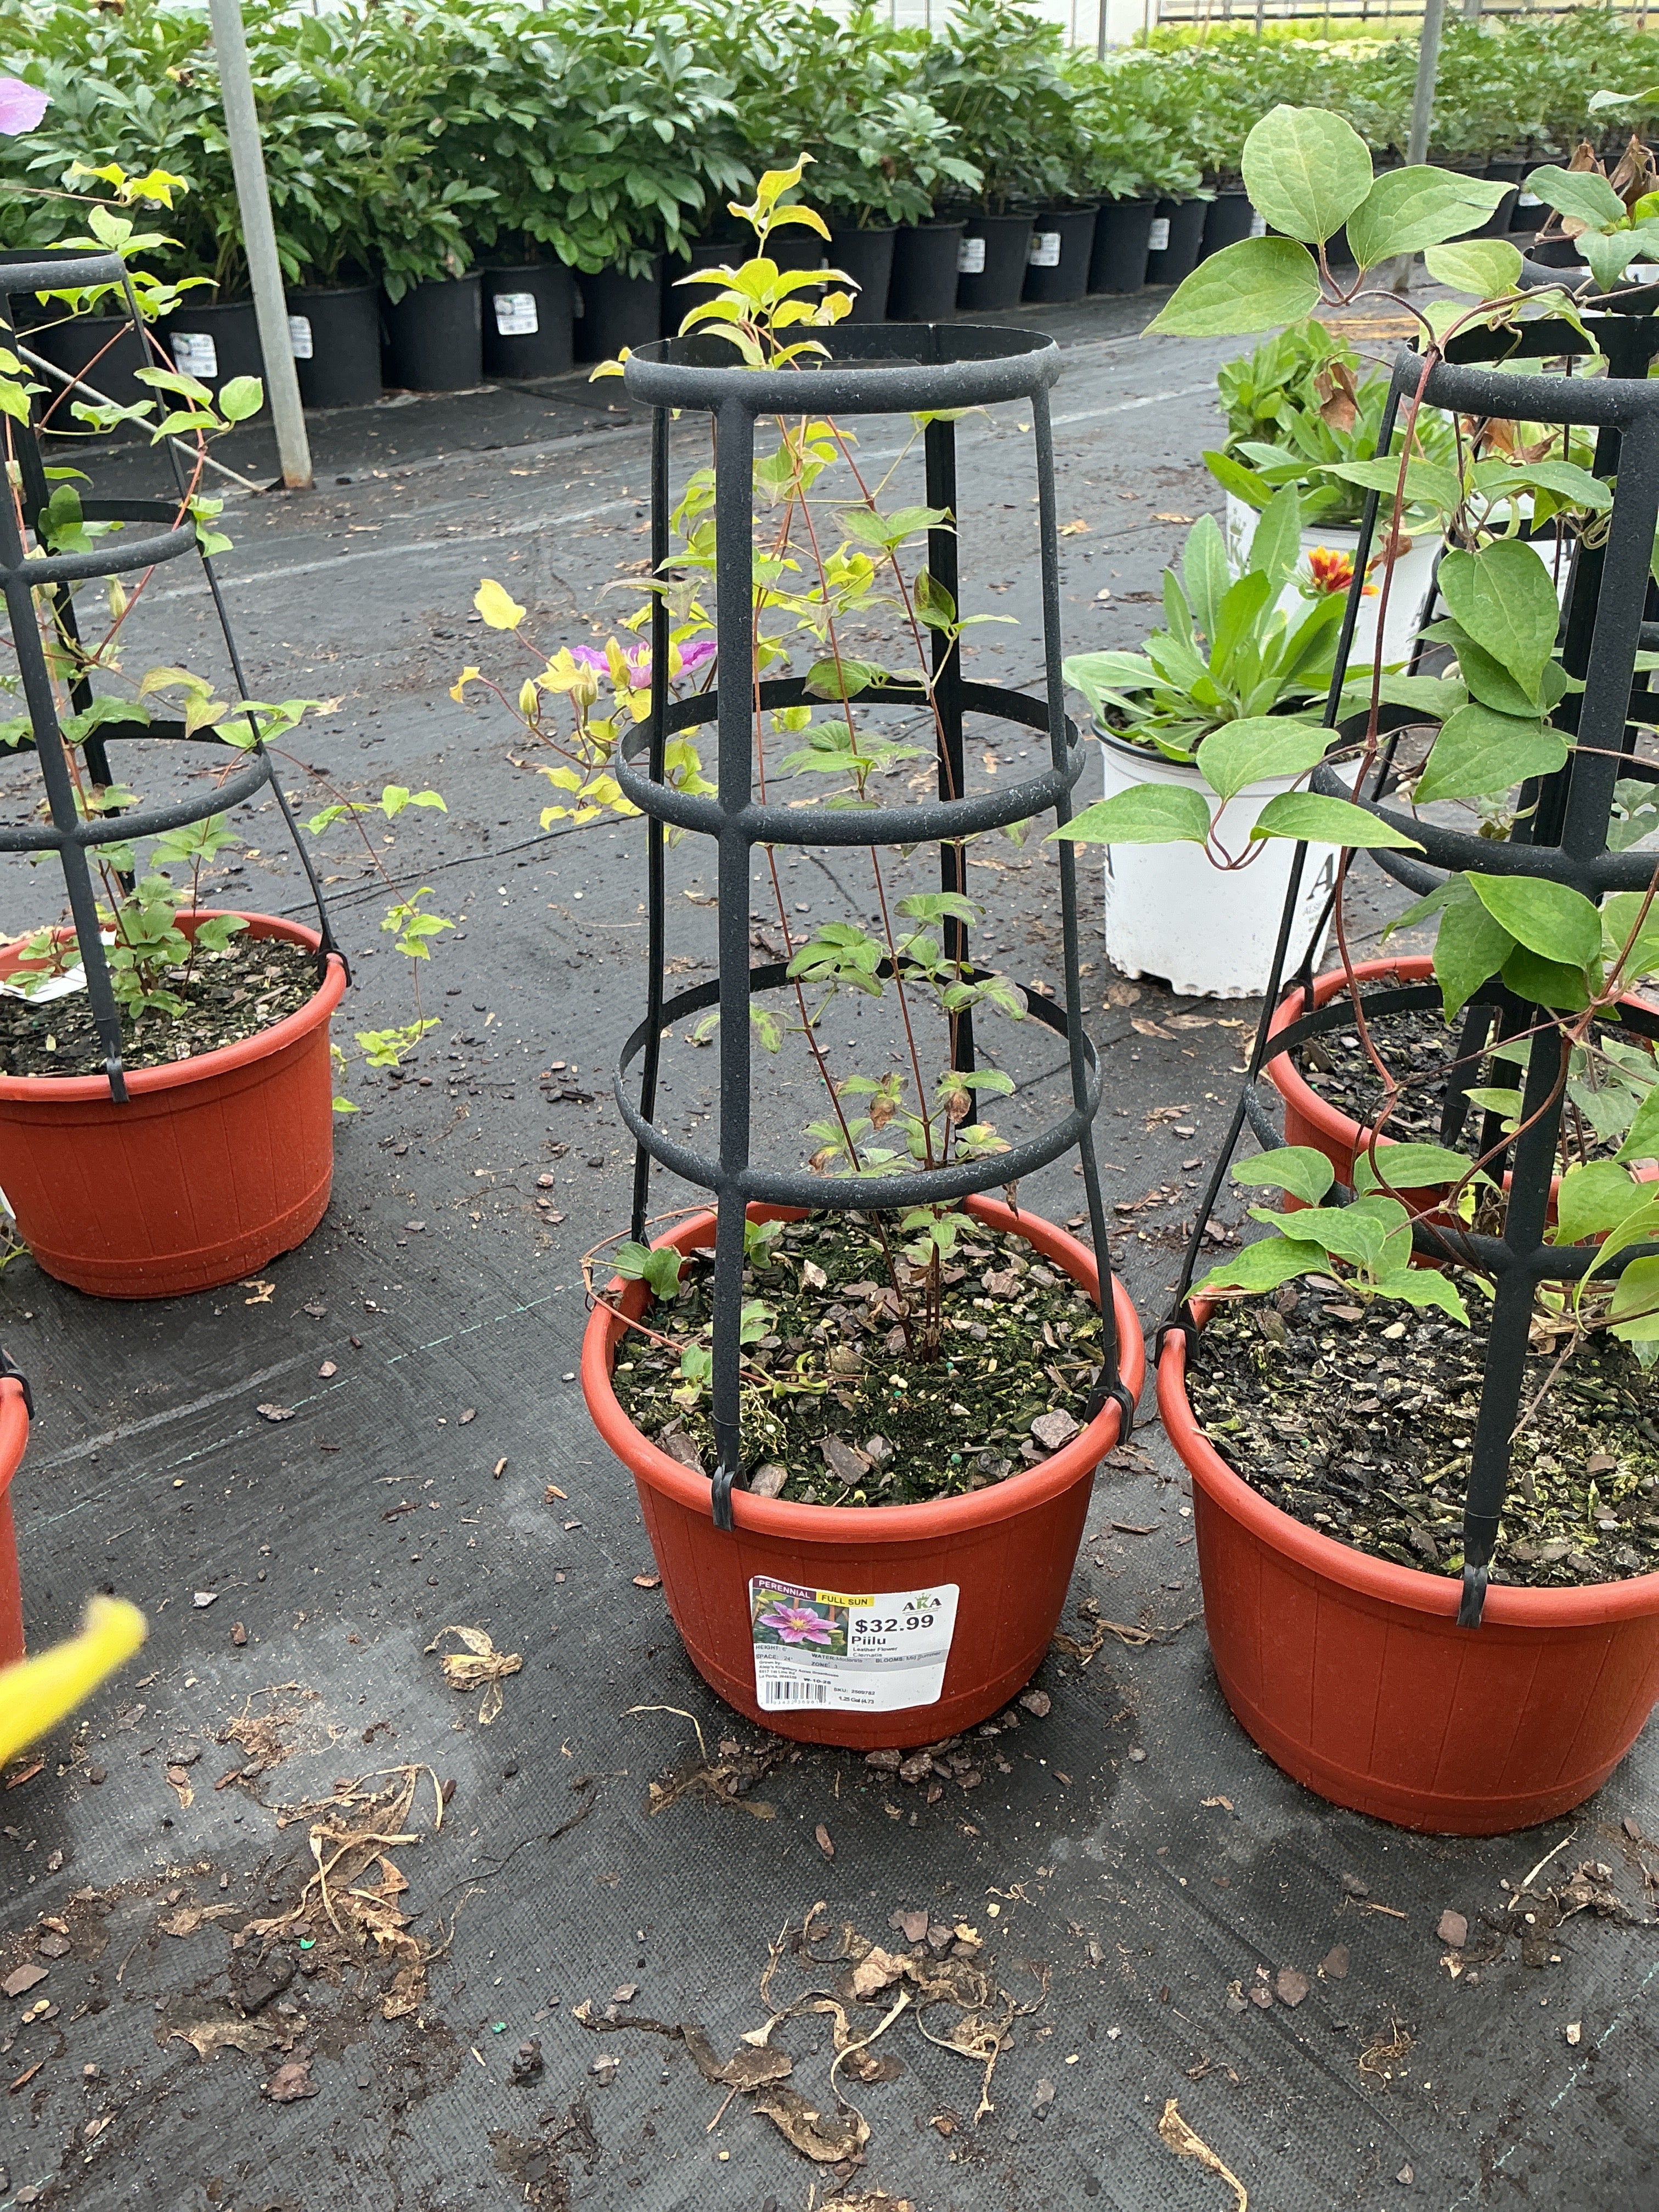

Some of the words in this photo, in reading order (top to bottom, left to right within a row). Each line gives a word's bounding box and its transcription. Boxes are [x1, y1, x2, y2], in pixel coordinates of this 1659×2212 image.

[759, 1580, 810, 1599] PERENNIAL
[821, 1594, 845, 1604] FULL
[902, 1597, 942, 1611] AKA
[855, 1615, 934, 1634] $32.99
[851, 1636, 886, 1645] Piilu
[917, 1651, 941, 1660] Summer
